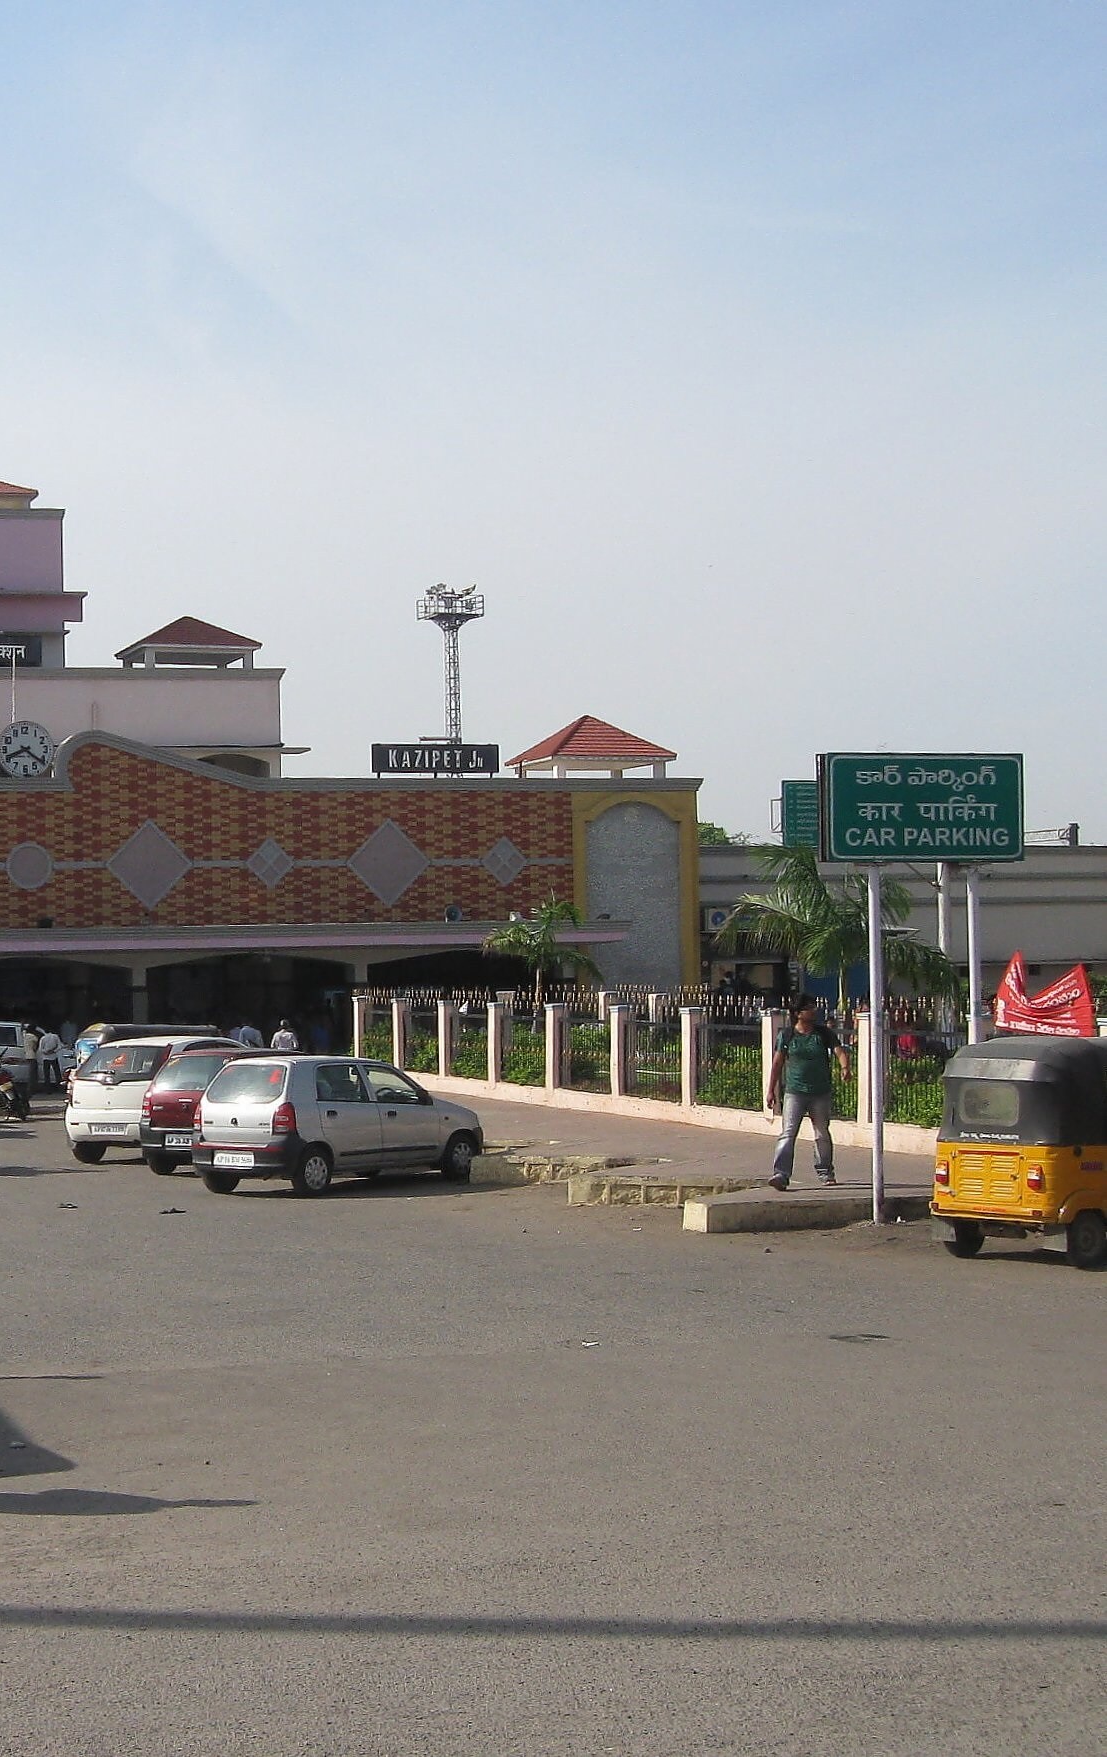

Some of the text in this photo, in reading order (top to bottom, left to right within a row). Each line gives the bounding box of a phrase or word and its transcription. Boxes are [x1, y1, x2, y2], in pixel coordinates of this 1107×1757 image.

[388, 749, 463, 768] KAZIPET
[855, 765, 997, 792] కార్ పార్కింగ్
[856, 794, 998, 822] कार पार्किंग
[845, 827, 1010, 847] CAR PARKING
